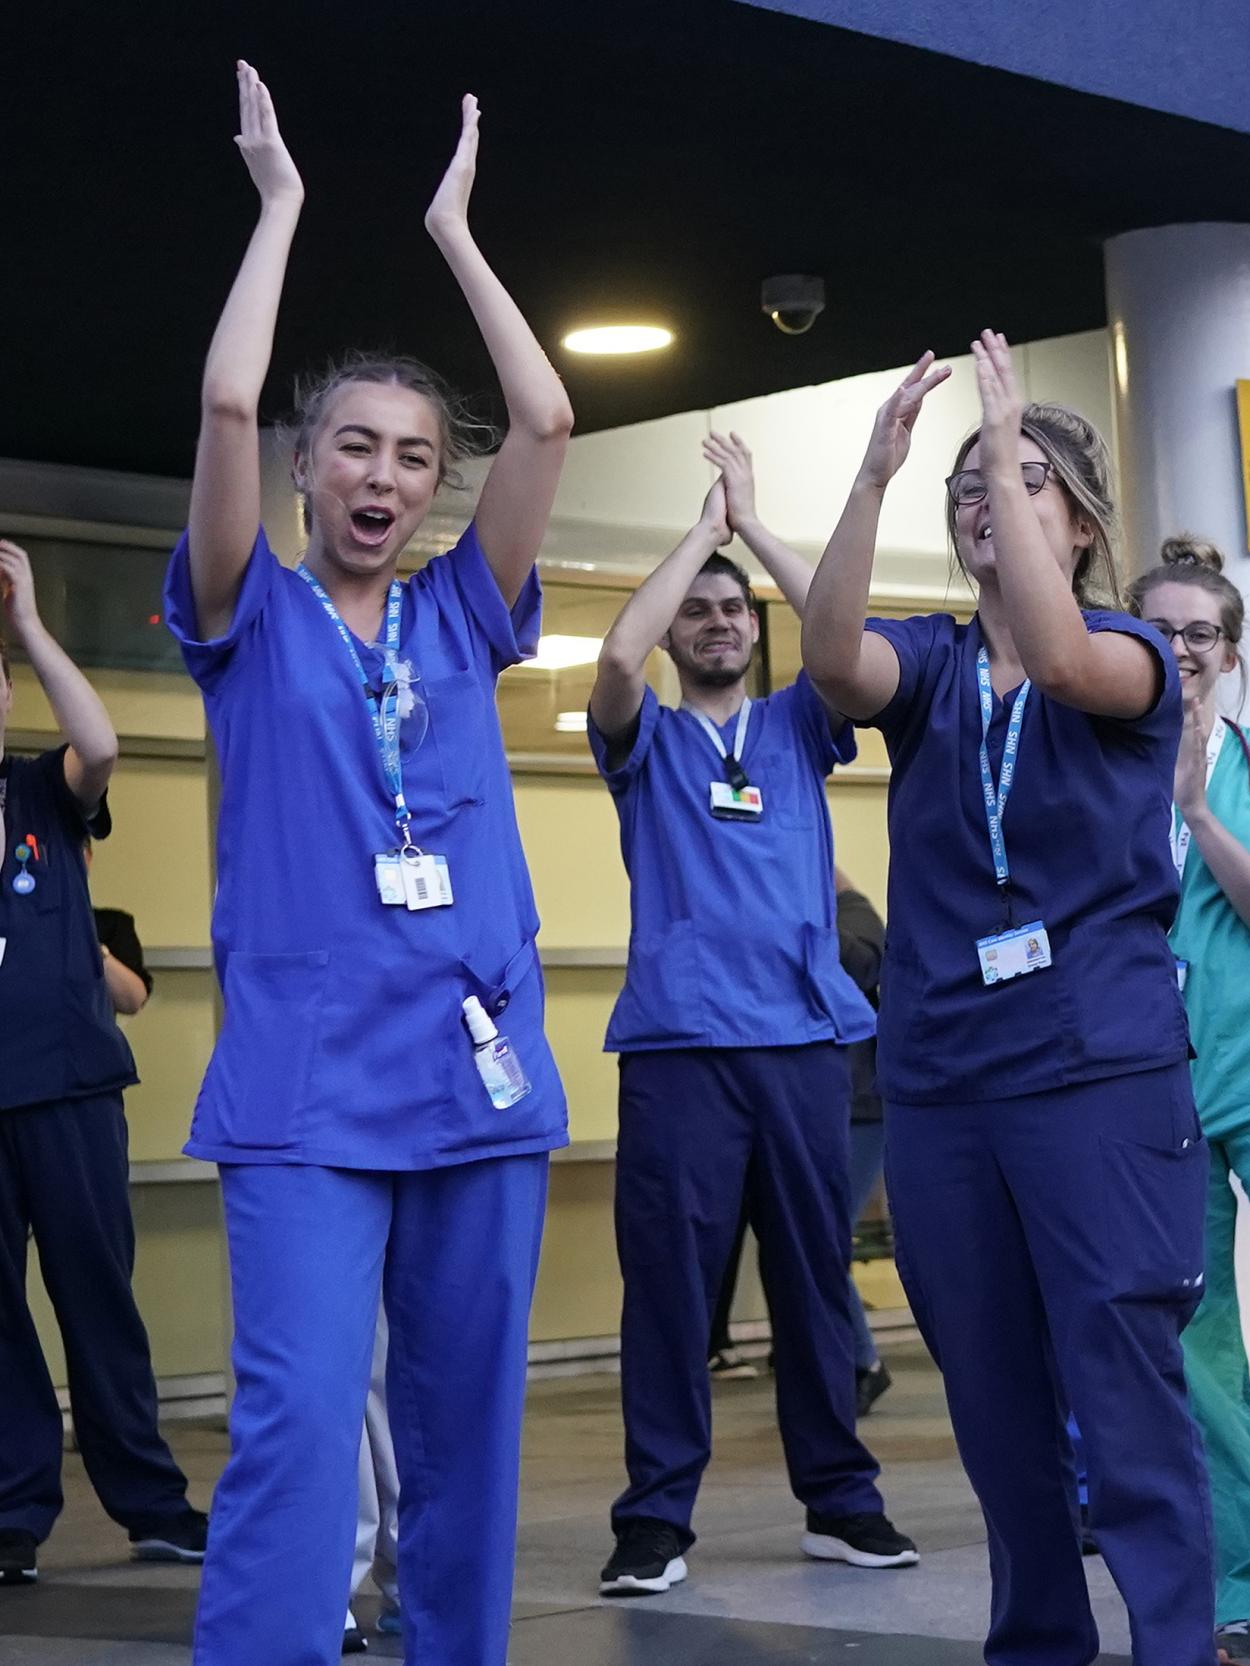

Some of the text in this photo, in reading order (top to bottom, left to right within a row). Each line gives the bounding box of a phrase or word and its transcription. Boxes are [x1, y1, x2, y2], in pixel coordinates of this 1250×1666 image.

[388, 601, 401, 618] NHS
[387, 622, 399, 642] NHS
[979, 667, 992, 687] NHS
[1011, 701, 1024, 723] NHS
[1006, 730, 1019, 755] NHS
[1001, 762, 1013, 786] NHS
[983, 782, 996, 808] NHS
